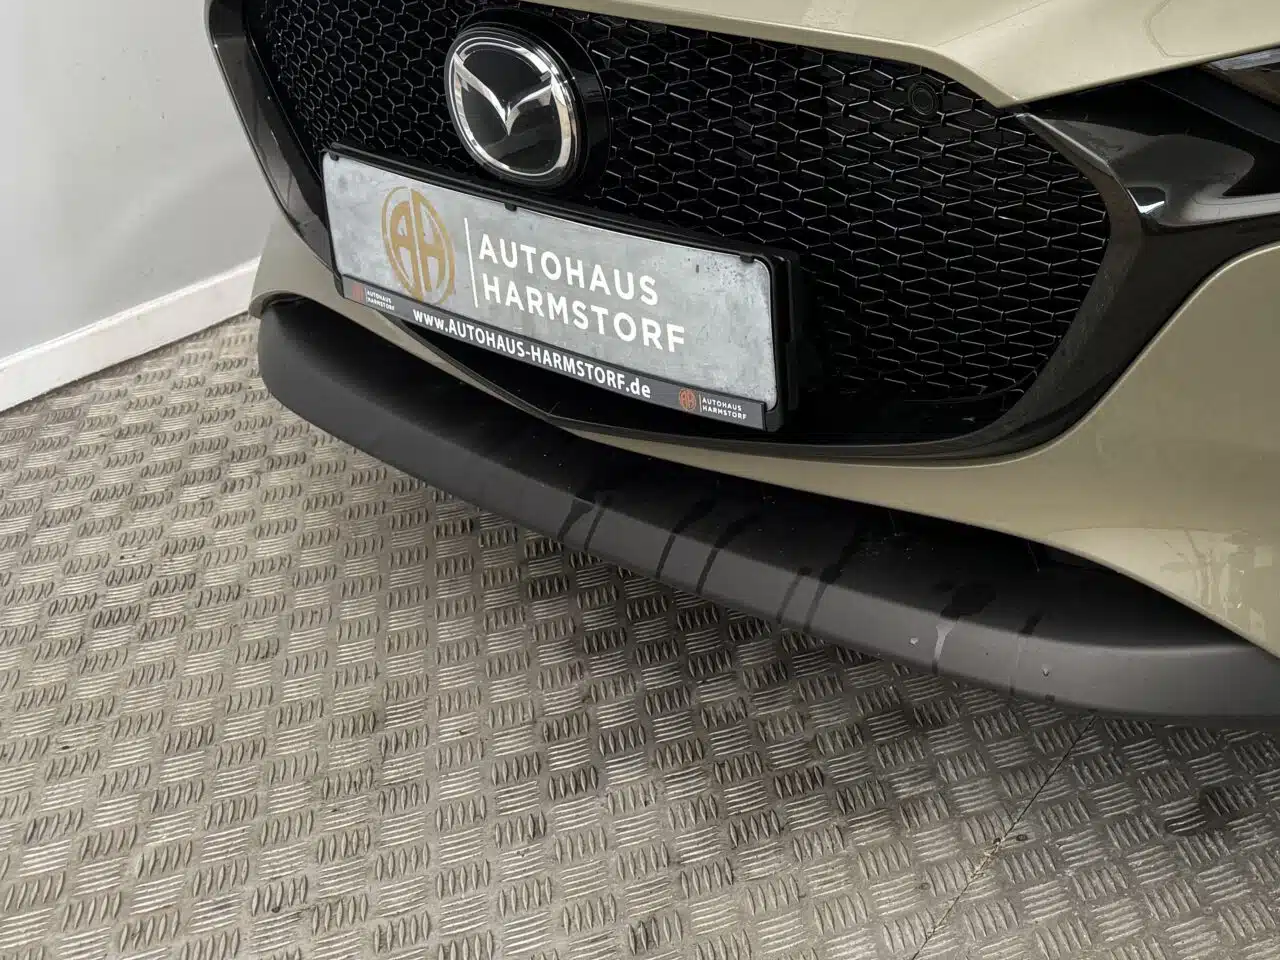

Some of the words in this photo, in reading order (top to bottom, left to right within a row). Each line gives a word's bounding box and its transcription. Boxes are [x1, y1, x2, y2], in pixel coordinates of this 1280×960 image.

[478, 233, 658, 306] AUTOHAUS
[483, 272, 685, 353] HARMSTORF
[412, 308, 651, 399] www.AUTOHAUS-HARMSTORF.de
[702, 397, 742, 412] AUTOHAUS
[702, 405, 747, 420] HARMSTORF
